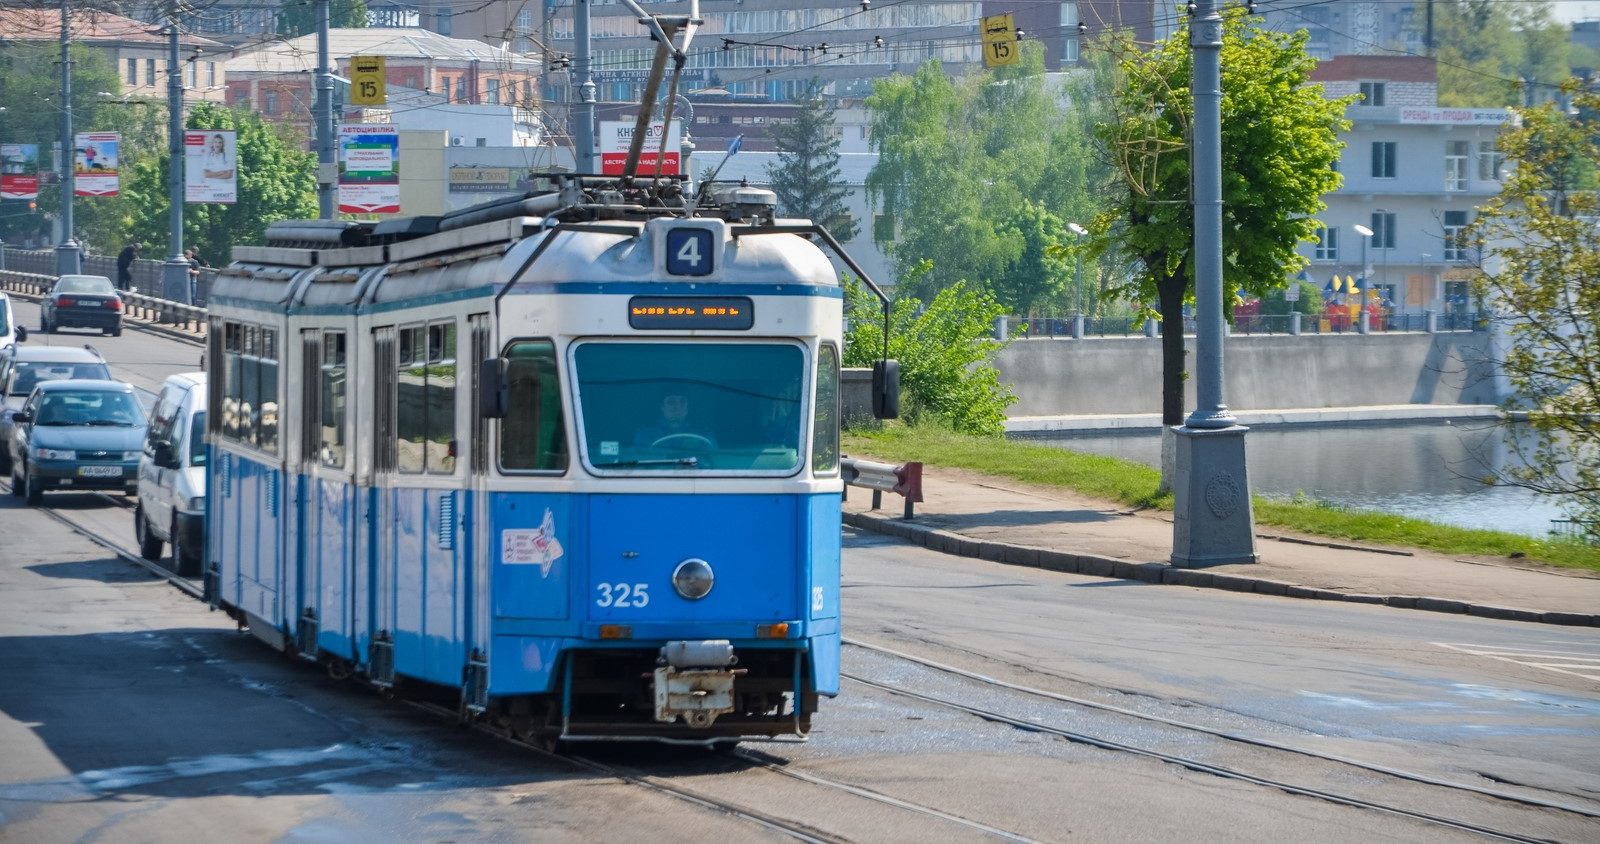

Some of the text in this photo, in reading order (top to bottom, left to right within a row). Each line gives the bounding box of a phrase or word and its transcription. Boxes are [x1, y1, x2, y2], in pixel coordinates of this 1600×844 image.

[992, 41, 1009, 58] 15
[621, 70, 651, 78] АГЕНЦІ
[359, 81, 377, 97] 15
[617, 128, 652, 137] княа
[677, 236, 702, 267] 4
[597, 583, 649, 608] 325
